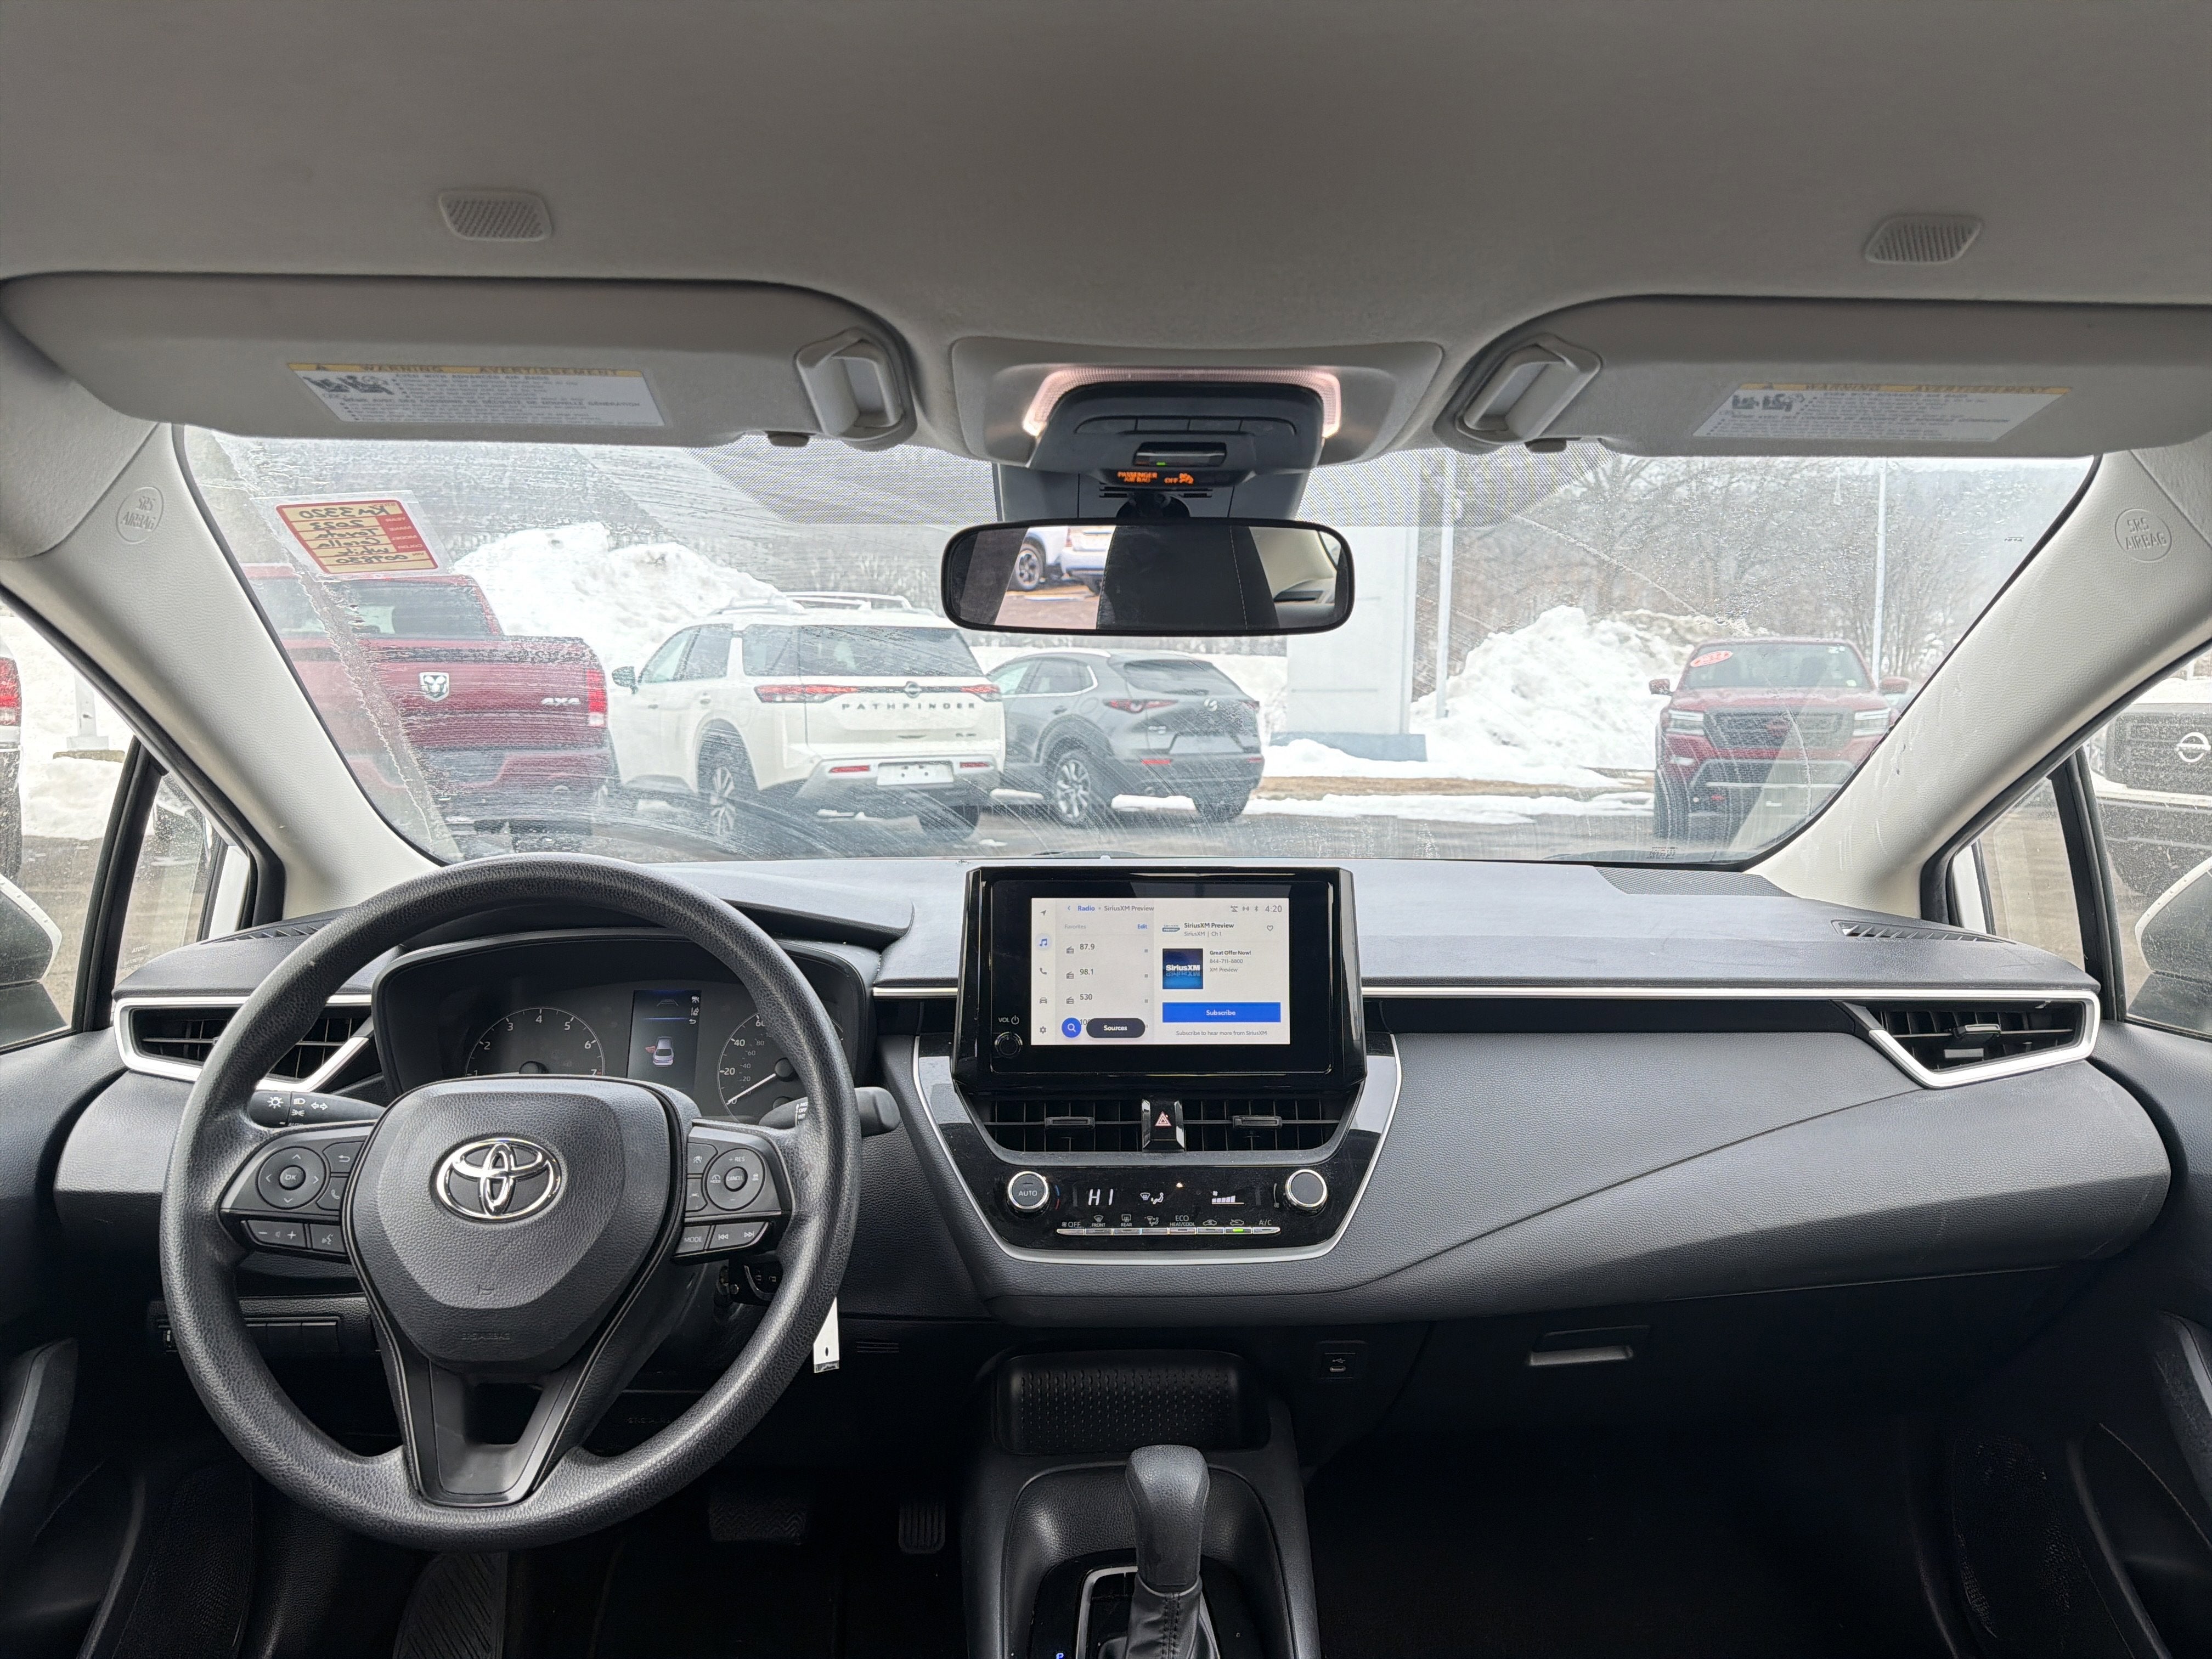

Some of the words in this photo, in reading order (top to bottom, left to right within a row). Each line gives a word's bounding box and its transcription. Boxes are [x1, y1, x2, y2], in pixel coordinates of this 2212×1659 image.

[842, 702, 975, 710] PATHFINDER
[1265, 905, 1283, 913] 4:20
[535, 1015, 543, 1023] 4
[507, 1023, 514, 1031] 3
[564, 1022, 571, 1030] 5
[483, 1042, 490, 1050] 2
[584, 1040, 591, 1049] 6
[1088, 1189, 1114, 1205] HI
